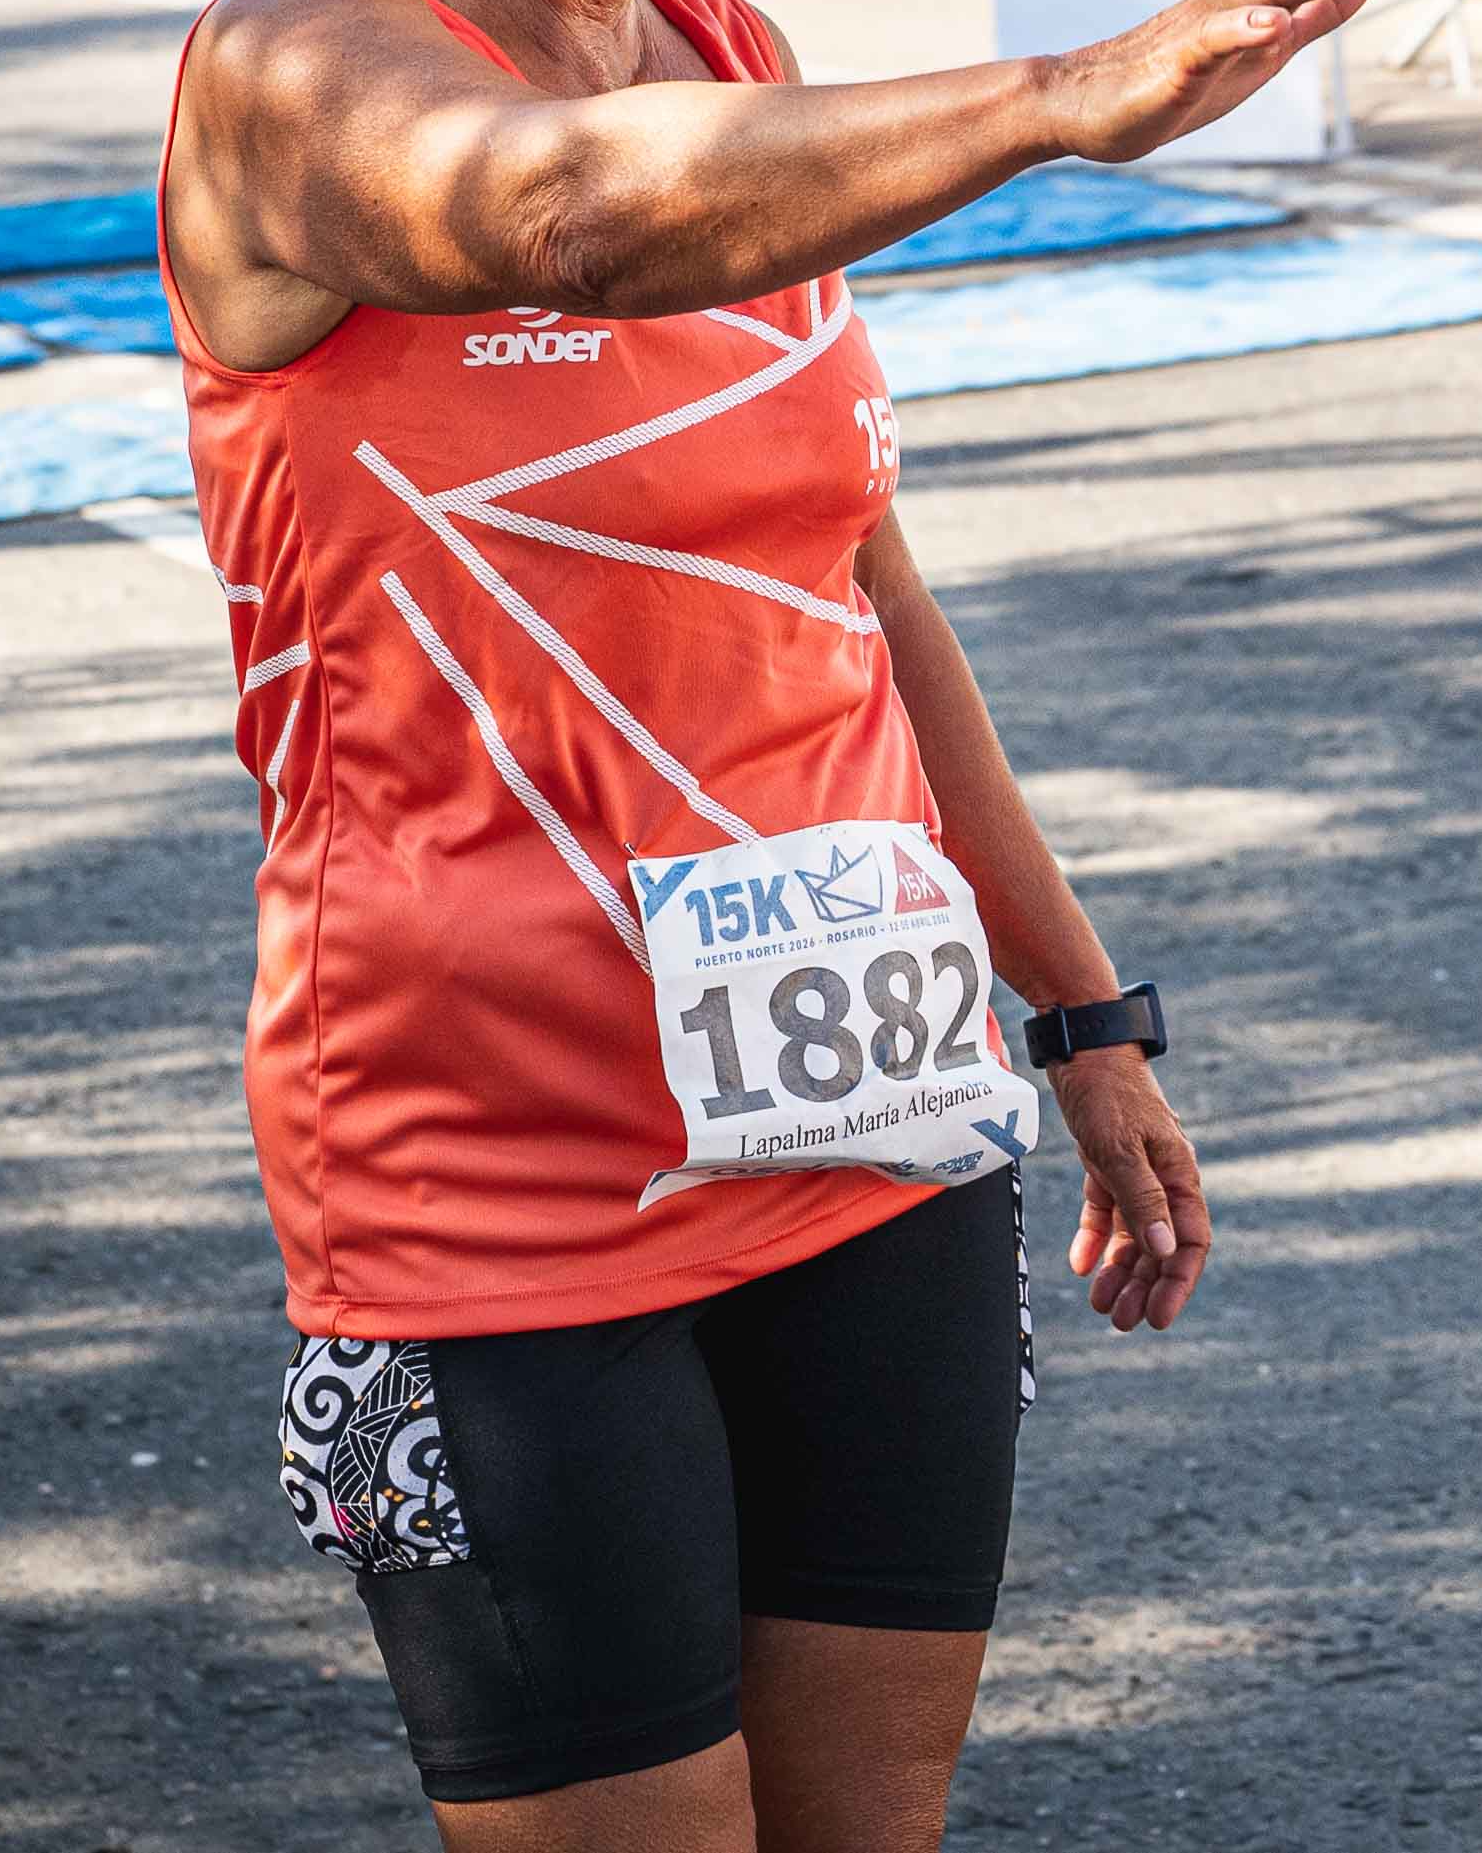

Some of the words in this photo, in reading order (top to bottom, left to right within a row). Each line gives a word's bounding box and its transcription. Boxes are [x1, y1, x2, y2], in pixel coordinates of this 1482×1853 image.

[684, 874, 797, 946] 15K
[899, 872, 936, 902] 15K
[695, 951, 743, 969] PUERTO
[746, 942, 786, 960] NORTE
[789, 938, 815, 953] 2026
[826, 924, 877, 945] ROSARIO
[889, 922, 899, 933] 12
[680, 941, 982, 1120] 1882
[739, 1124, 836, 1160] Lapalma
[842, 1103, 901, 1138] María
[905, 1079, 994, 1120] Alejandra
